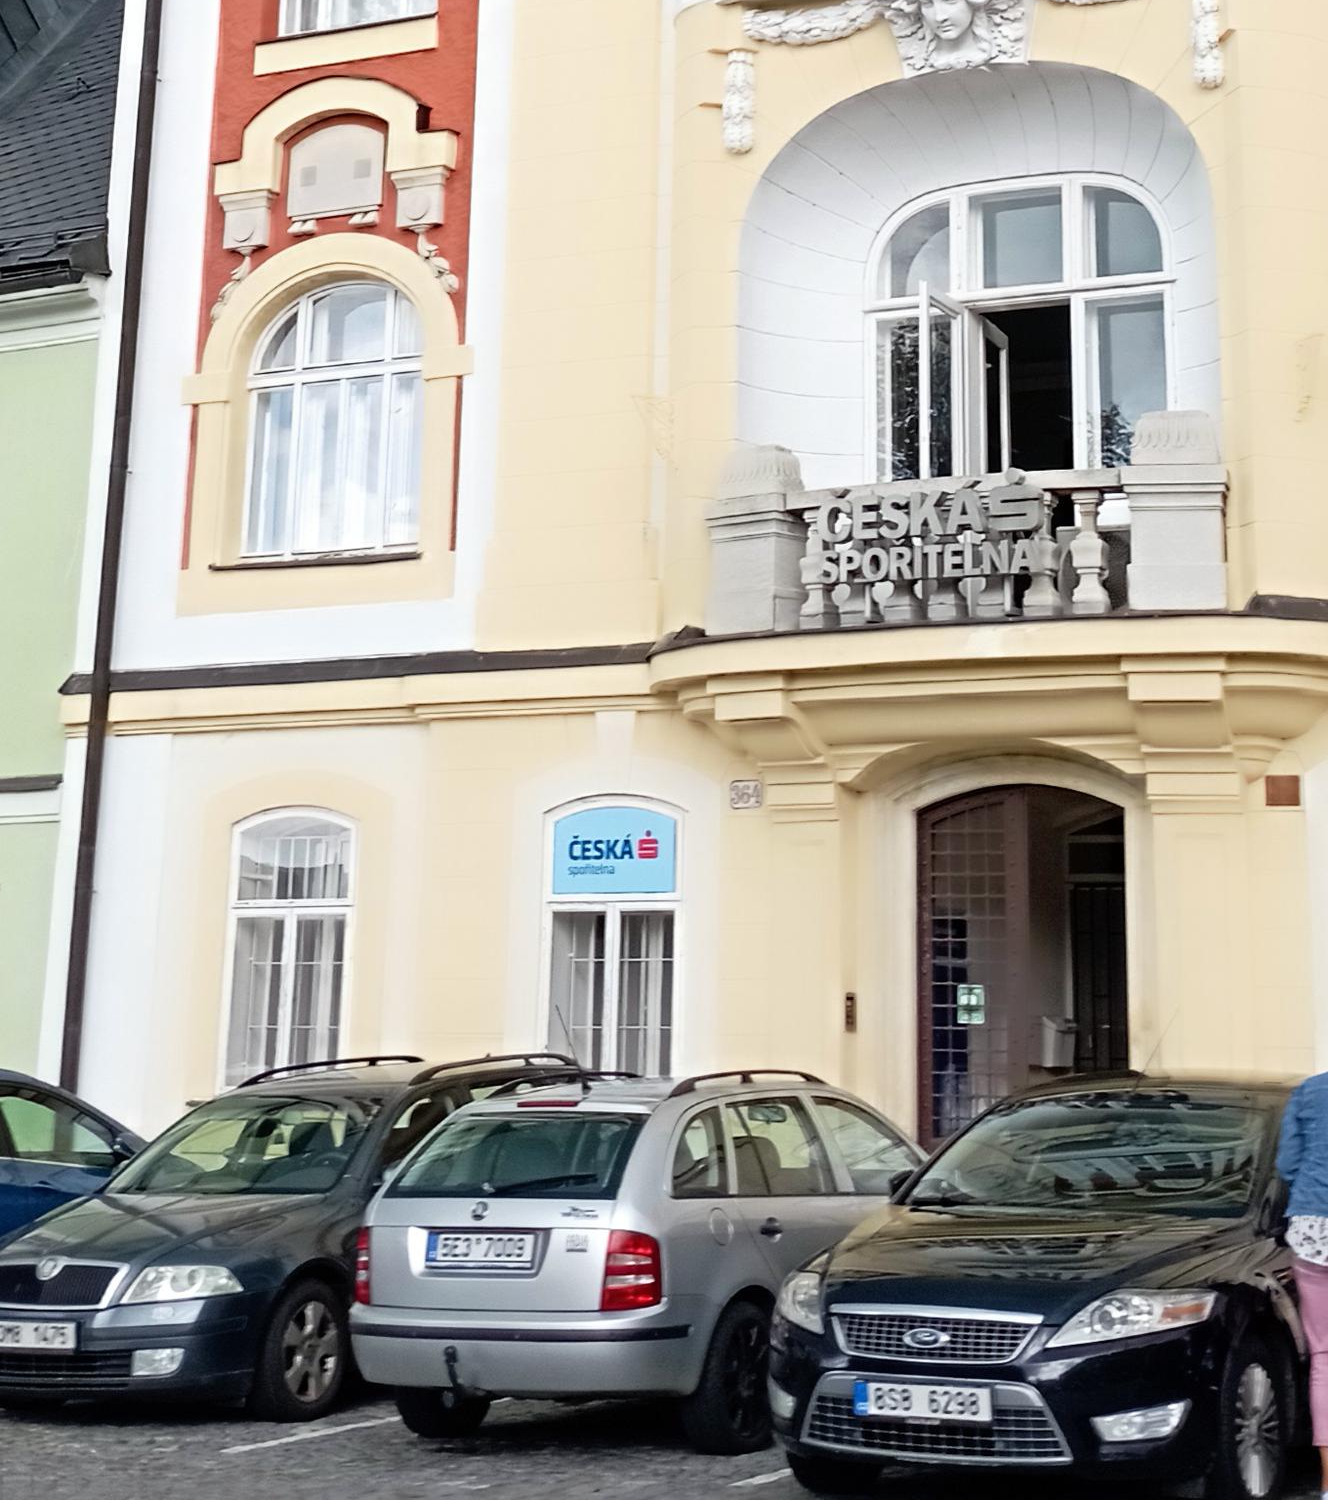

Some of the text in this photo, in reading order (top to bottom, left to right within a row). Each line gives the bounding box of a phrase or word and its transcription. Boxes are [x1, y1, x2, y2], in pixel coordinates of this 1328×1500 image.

[815, 480, 988, 542] ČESKÁ
[821, 537, 1038, 584] SPOŘITELNA
[731, 783, 762, 805] 364
[568, 834, 634, 861] ČESKÁ
[567, 863, 615, 878] spořitelna
